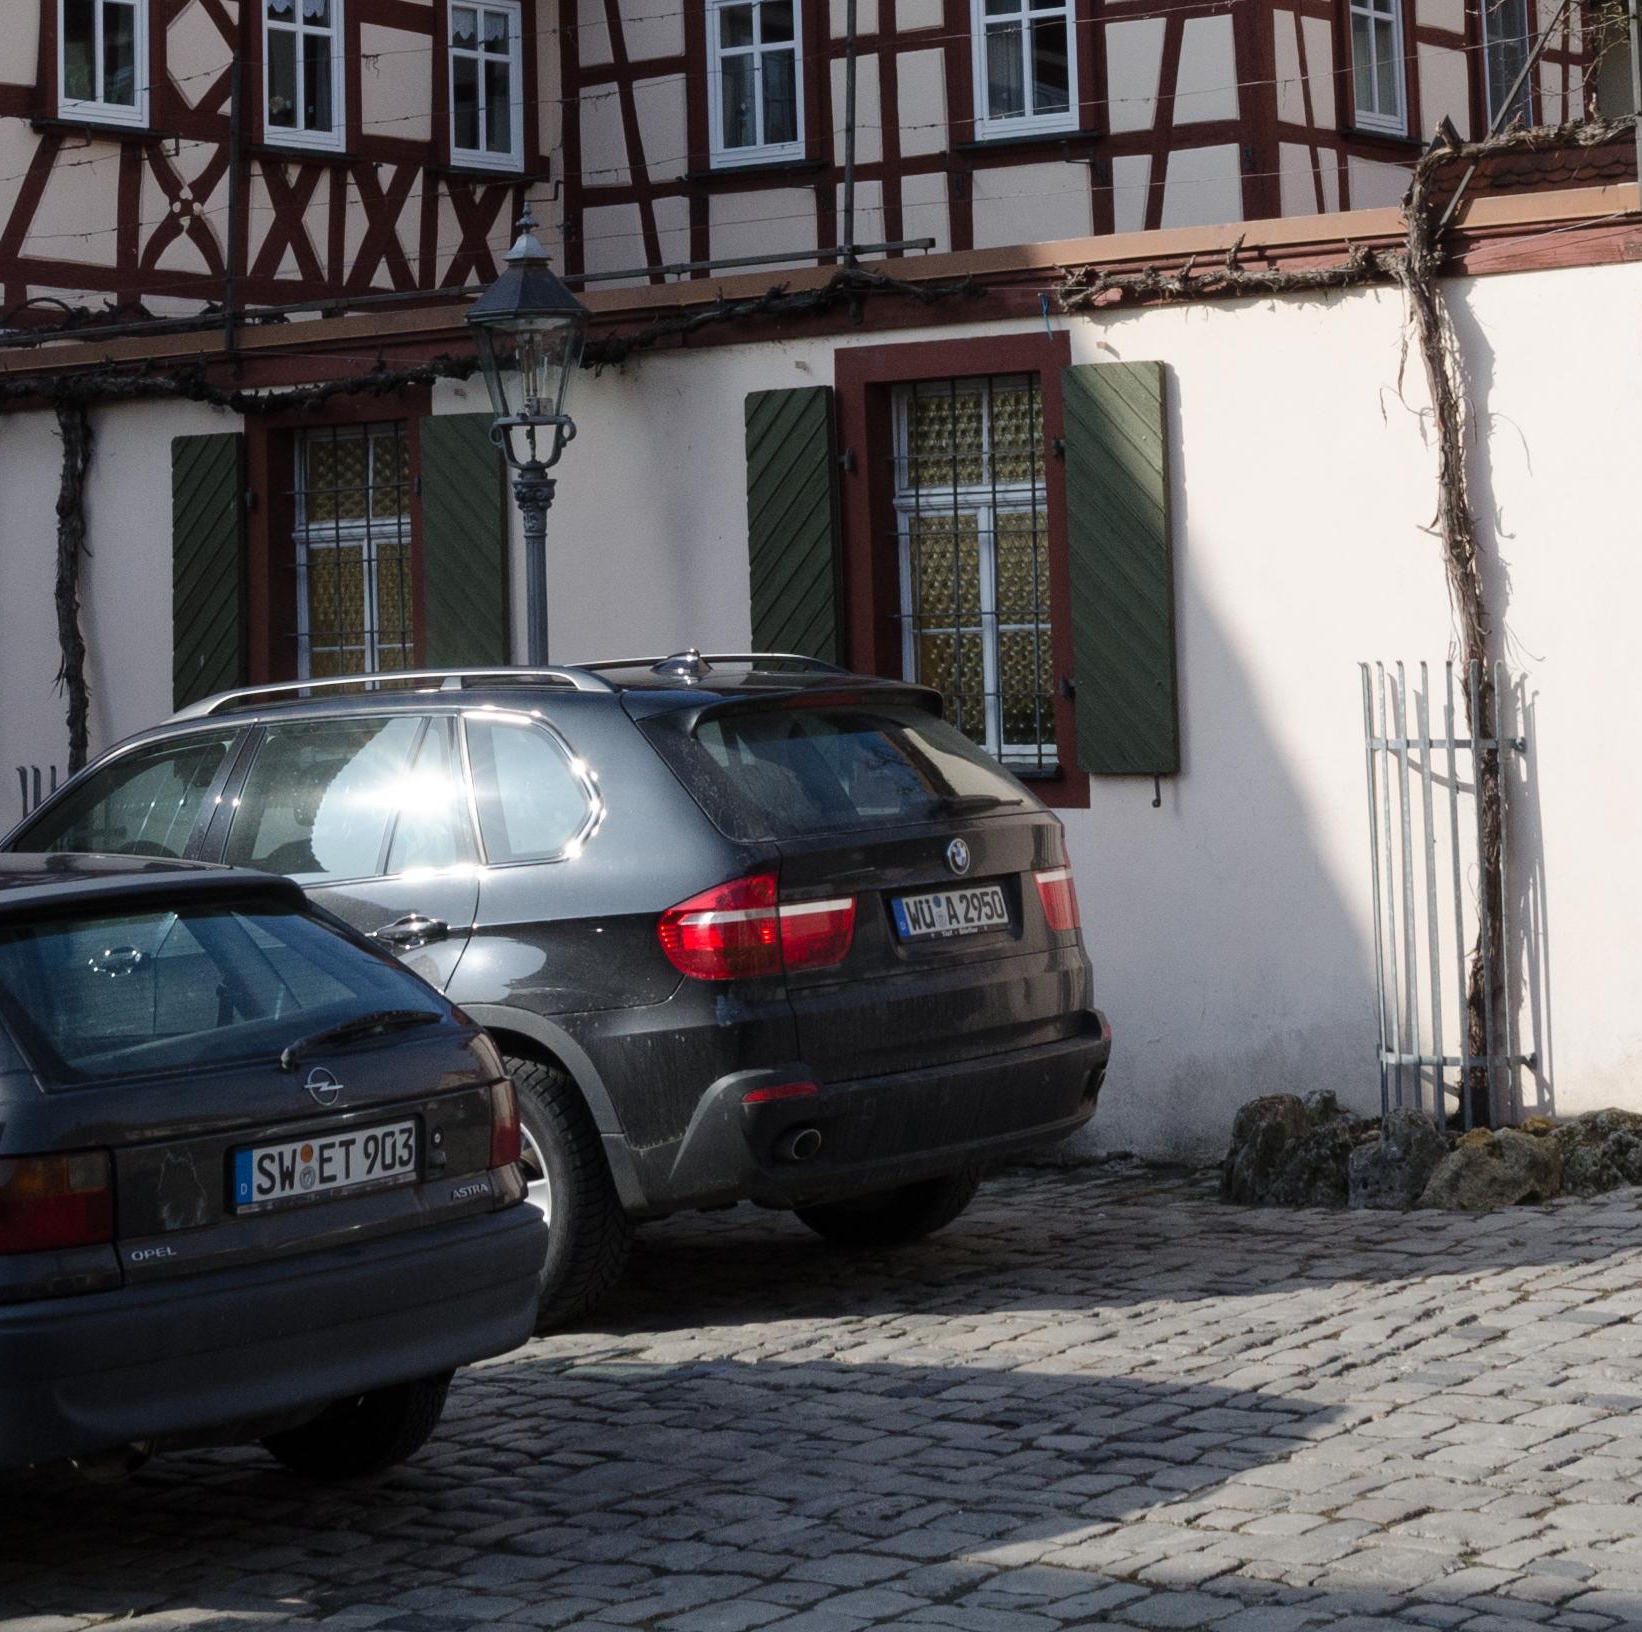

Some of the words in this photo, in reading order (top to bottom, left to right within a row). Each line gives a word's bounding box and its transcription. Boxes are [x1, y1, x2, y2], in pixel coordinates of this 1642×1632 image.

[905, 898, 936, 931] WÜ
[945, 896, 960, 925] A
[959, 890, 1005, 923] 2950
[257, 1151, 297, 1196] SW
[318, 1138, 356, 1185] ET
[363, 1127, 414, 1174] 903
[451, 1183, 489, 1200] ASTRA
[131, 1246, 177, 1262] OPEL
